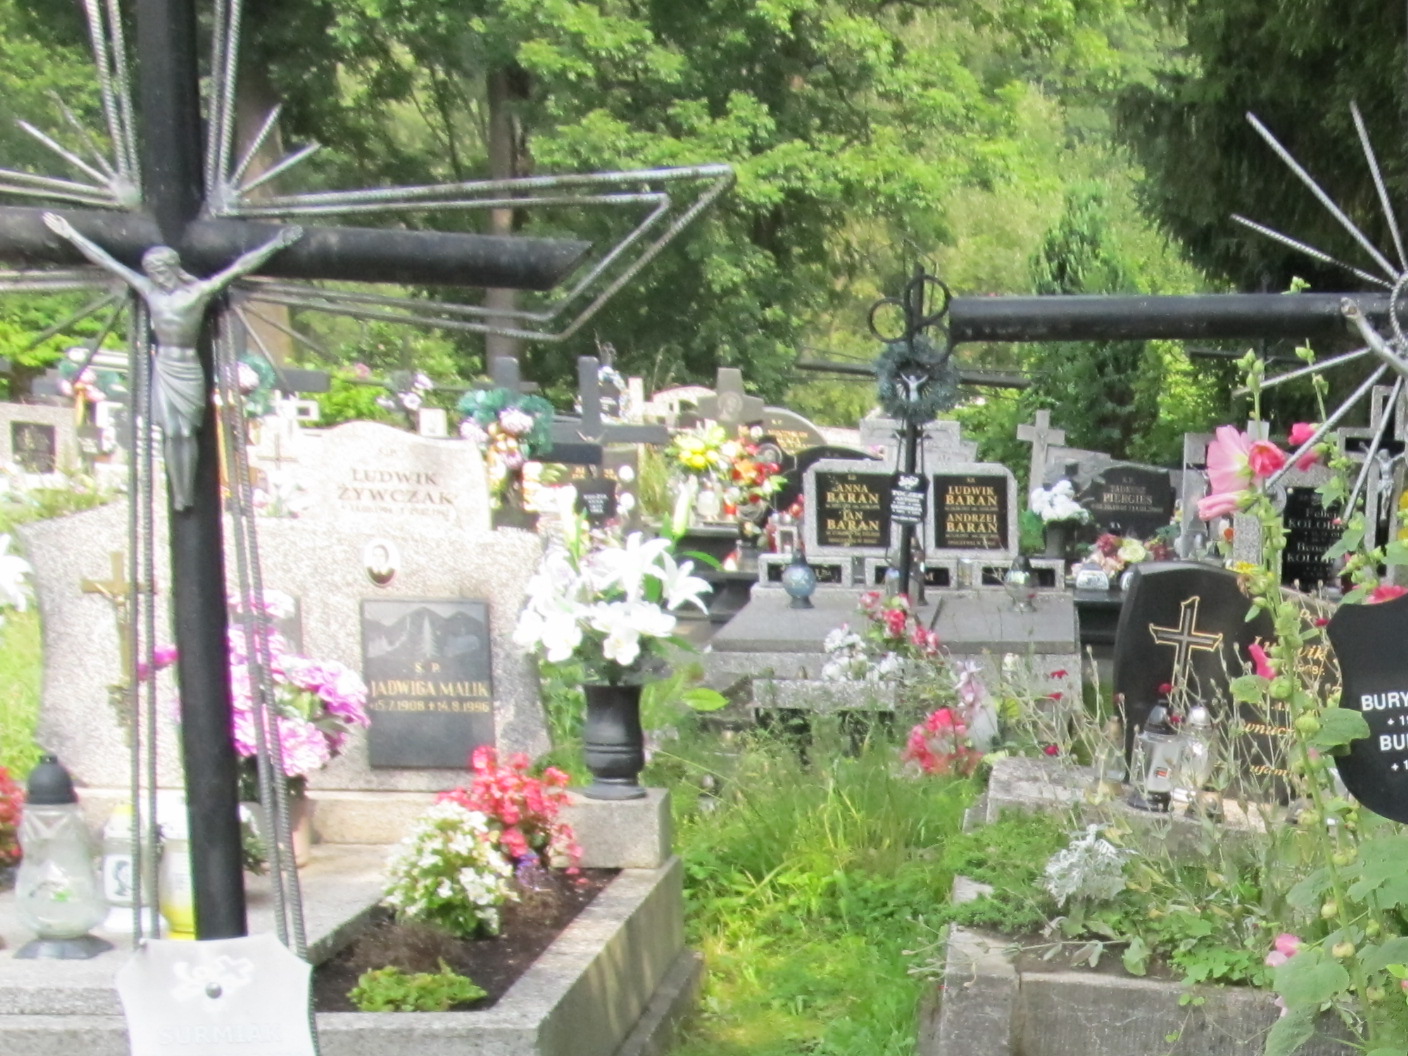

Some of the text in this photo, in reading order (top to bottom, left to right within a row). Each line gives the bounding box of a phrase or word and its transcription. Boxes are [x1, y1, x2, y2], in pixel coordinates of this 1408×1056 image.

[351, 468, 441, 487] LUDWIK
[836, 484, 868, 493] ANNA
[948, 486, 994, 496] LUDWIK
[826, 492, 879, 504] BARAN
[946, 495, 998, 506] BARAN
[843, 510, 863, 521] JAN
[947, 514, 997, 523] ANDRZEJ
[827, 519, 880, 531] BARAN
[946, 522, 998, 533] BARAN
[370, 680, 490, 698] JADWIGA MALIK
[158, 1023, 284, 1046] SURMIAK
